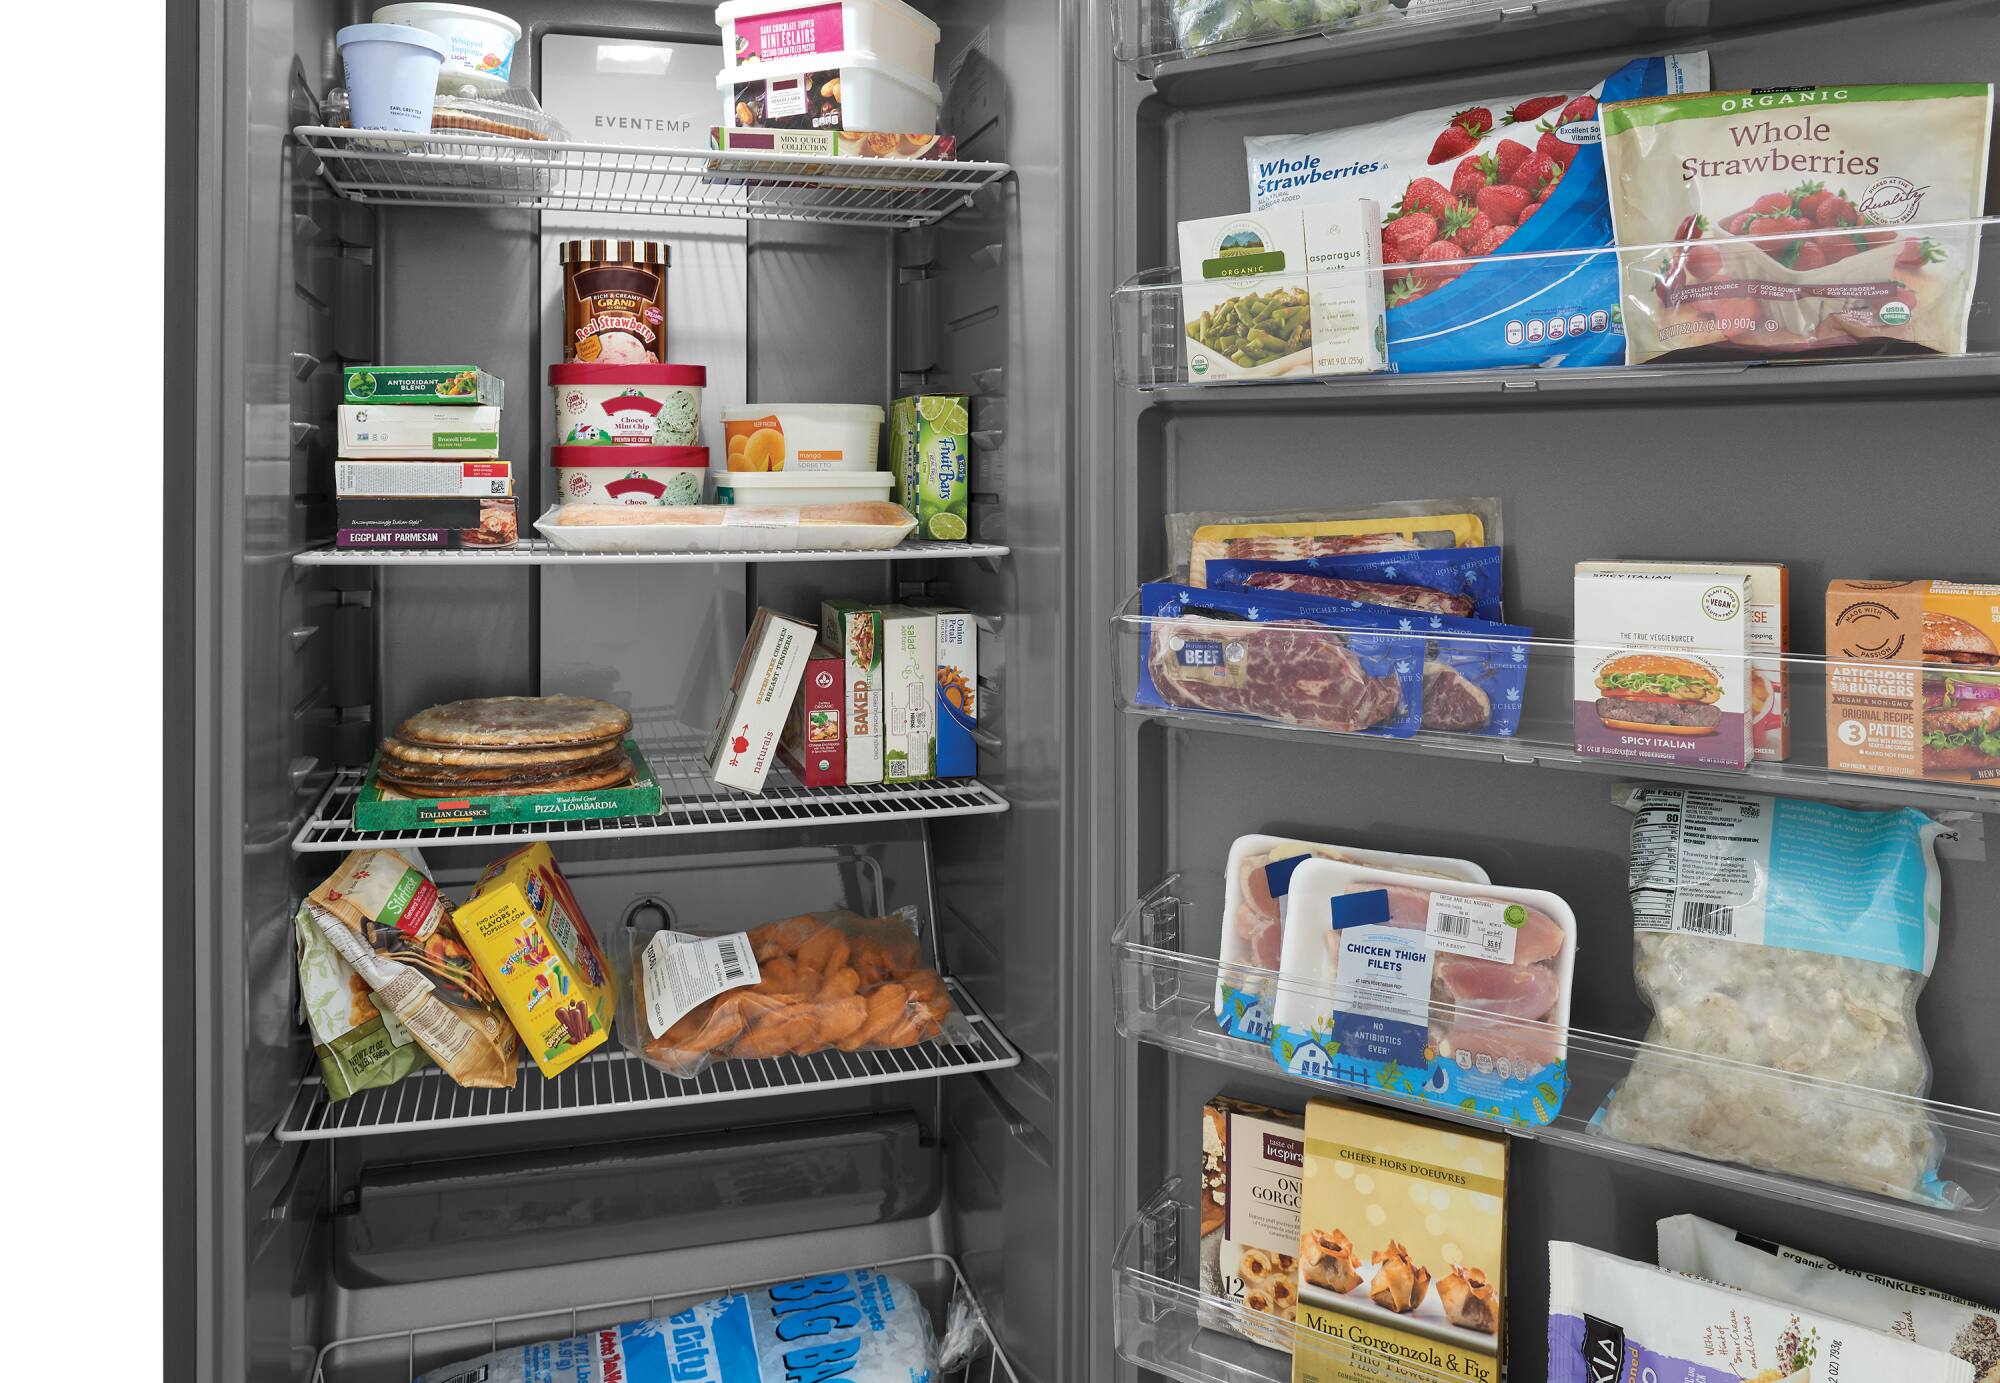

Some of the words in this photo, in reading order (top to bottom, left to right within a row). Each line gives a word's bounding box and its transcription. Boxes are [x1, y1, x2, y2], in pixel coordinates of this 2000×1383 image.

[761, 33, 780, 49] MINI
[781, 28, 815, 47] ECLAIRS
[1721, 89, 1849, 112] ORGANIC
[594, 115, 692, 133] EVENTEMP
[1560, 126, 1589, 135] Excellent
[1728, 115, 1831, 148] Whole
[801, 137, 828, 145] QUICHE
[1571, 134, 1595, 142] Vitamin
[782, 143, 827, 151] COLLECTION
[1258, 154, 1321, 179] Whole
[1681, 148, 1880, 182] Strawberries
[1256, 160, 1380, 197] Strawberries
[1898, 179, 1909, 189] THE
[1858, 184, 1932, 213] Quality
[1309, 249, 1361, 264] asparagus
[1221, 265, 1264, 276] ORGANIC
[616, 293, 641, 301] CREAMY
[1681, 286, 1713, 296] EXCELLENT
[1689, 291, 1713, 300] VITAMIN
[1827, 286, 1876, 295] QUICK-FROZEN
[597, 299, 636, 308] GRAND
[1885, 306, 1905, 314] USDA
[576, 317, 599, 341] Real
[598, 315, 656, 343] Strawberry
[1681, 322, 1691, 334] 32
[1693, 321, 1704, 333] OZ
[1706, 319, 1716, 332] (2
[1717, 318, 1732, 331] LB)
[1734, 318, 1756, 331] 907g
[633, 423, 650, 431] Chip
[800, 452, 821, 460] mango
[938, 436, 957, 471] Fruit
[938, 470, 956, 501] Bars
[350, 532, 392, 542] EGGPLANT
[395, 532, 438, 542] PARMESAN
[1300, 606, 1338, 615] BUTCHER
[1710, 598, 1732, 609] VEGAN
[1845, 609, 1862, 624] MADE
[1864, 607, 1883, 616] WITH
[907, 624, 917, 650] salad
[949, 618, 957, 644] Petals
[956, 618, 965, 645] Onion
[1620, 632, 1632, 640] THE
[1634, 633, 1648, 641] TRUE
[1650, 633, 1695, 643] VEGGIEBURGER
[773, 627, 788, 658] CHICKEN
[1185, 649, 1220, 665] BEEF
[1860, 646, 1893, 659] PASSION
[764, 672, 780, 703] BREAST
[777, 634, 793, 671] TENDERS
[1832, 666, 1915, 686] ARTICHOKE
[1849, 682, 1915, 697] BURGERS
[854, 680, 869, 736] BAKED
[1836, 696, 1861, 704] VEGAN
[1871, 699, 1909, 708] NON-GMO
[1841, 708, 1882, 722] ORIGINAL
[1883, 711, 1915, 724] RECIPE
[1847, 724, 1862, 743] 3
[1869, 722, 1915, 739] PATTIES
[1576, 744, 1583, 752] 2
[1621, 736, 1651, 746] SPICY
[1654, 738, 1696, 750] ITALIAN
[753, 730, 774, 774] naturals
[1977, 768, 1994, 779] NEW
[1657, 789, 1682, 798] Facts
[420, 809, 452, 819] ITALIAN
[453, 808, 488, 817] CLASSICS
[535, 803, 561, 814] PIZZA
[562, 800, 618, 812] LOMBARDIA
[1666, 813, 1679, 824] 80
[1683, 850, 1709, 860] Thawing
[476, 917, 489, 927] FIND
[489, 912, 499, 920] ALL
[498, 904, 510, 914] OUR
[480, 911, 511, 932] FLAVORS
[511, 907, 518, 915] AT
[483, 911, 526, 938] POPSICLE.COM
[1346, 943, 1392, 958] CHICKEN
[1394, 950, 1427, 963] THIGH
[1367, 959, 1403, 972] FILETS
[1373, 1022, 1384, 1031] NO
[1354, 1031, 1402, 1046] ANTIBIOTICS
[1269, 1138, 1285, 1148] taste
[1286, 1142, 1295, 1151] of
[1340, 1149, 1377, 1166] CHEESE
[1379, 1157, 1408, 1172] HORS
[1410, 1162, 1467, 1186] D'OEUVRES
[1224, 1275, 1245, 1298] 12
[1783, 1251, 1824, 1270] organic
[1826, 1262, 1862, 1279] OVEN
[1865, 1272, 1927, 1297] CRINKLES
[1928, 1291, 1941, 1299] WITH
[1940, 1293, 1952, 1302] SEA
[1952, 1295, 1967, 1306] SALT
[768, 1273, 862, 1342] BIG
[860, 1282, 886, 1332] Nuggets
[1729, 1308, 1742, 1343] Cream
[1743, 1315, 1755, 1352] Chives
[672, 1323, 710, 1381] City
[1305, 1312, 1345, 1339] Mini
[1348, 1325, 1442, 1368] Gorgonzola
[1445, 1353, 1461, 1373] &
[1463, 1357, 1491, 1383] Fig
[1718, 1334, 1729, 1356] Hint
[1733, 1343, 1744, 1364] Sour
[1828, 1339, 1843, 1362] 793g
[1747, 1351, 1758, 1370] and
[1828, 1361, 1841, 1378] OZ)
